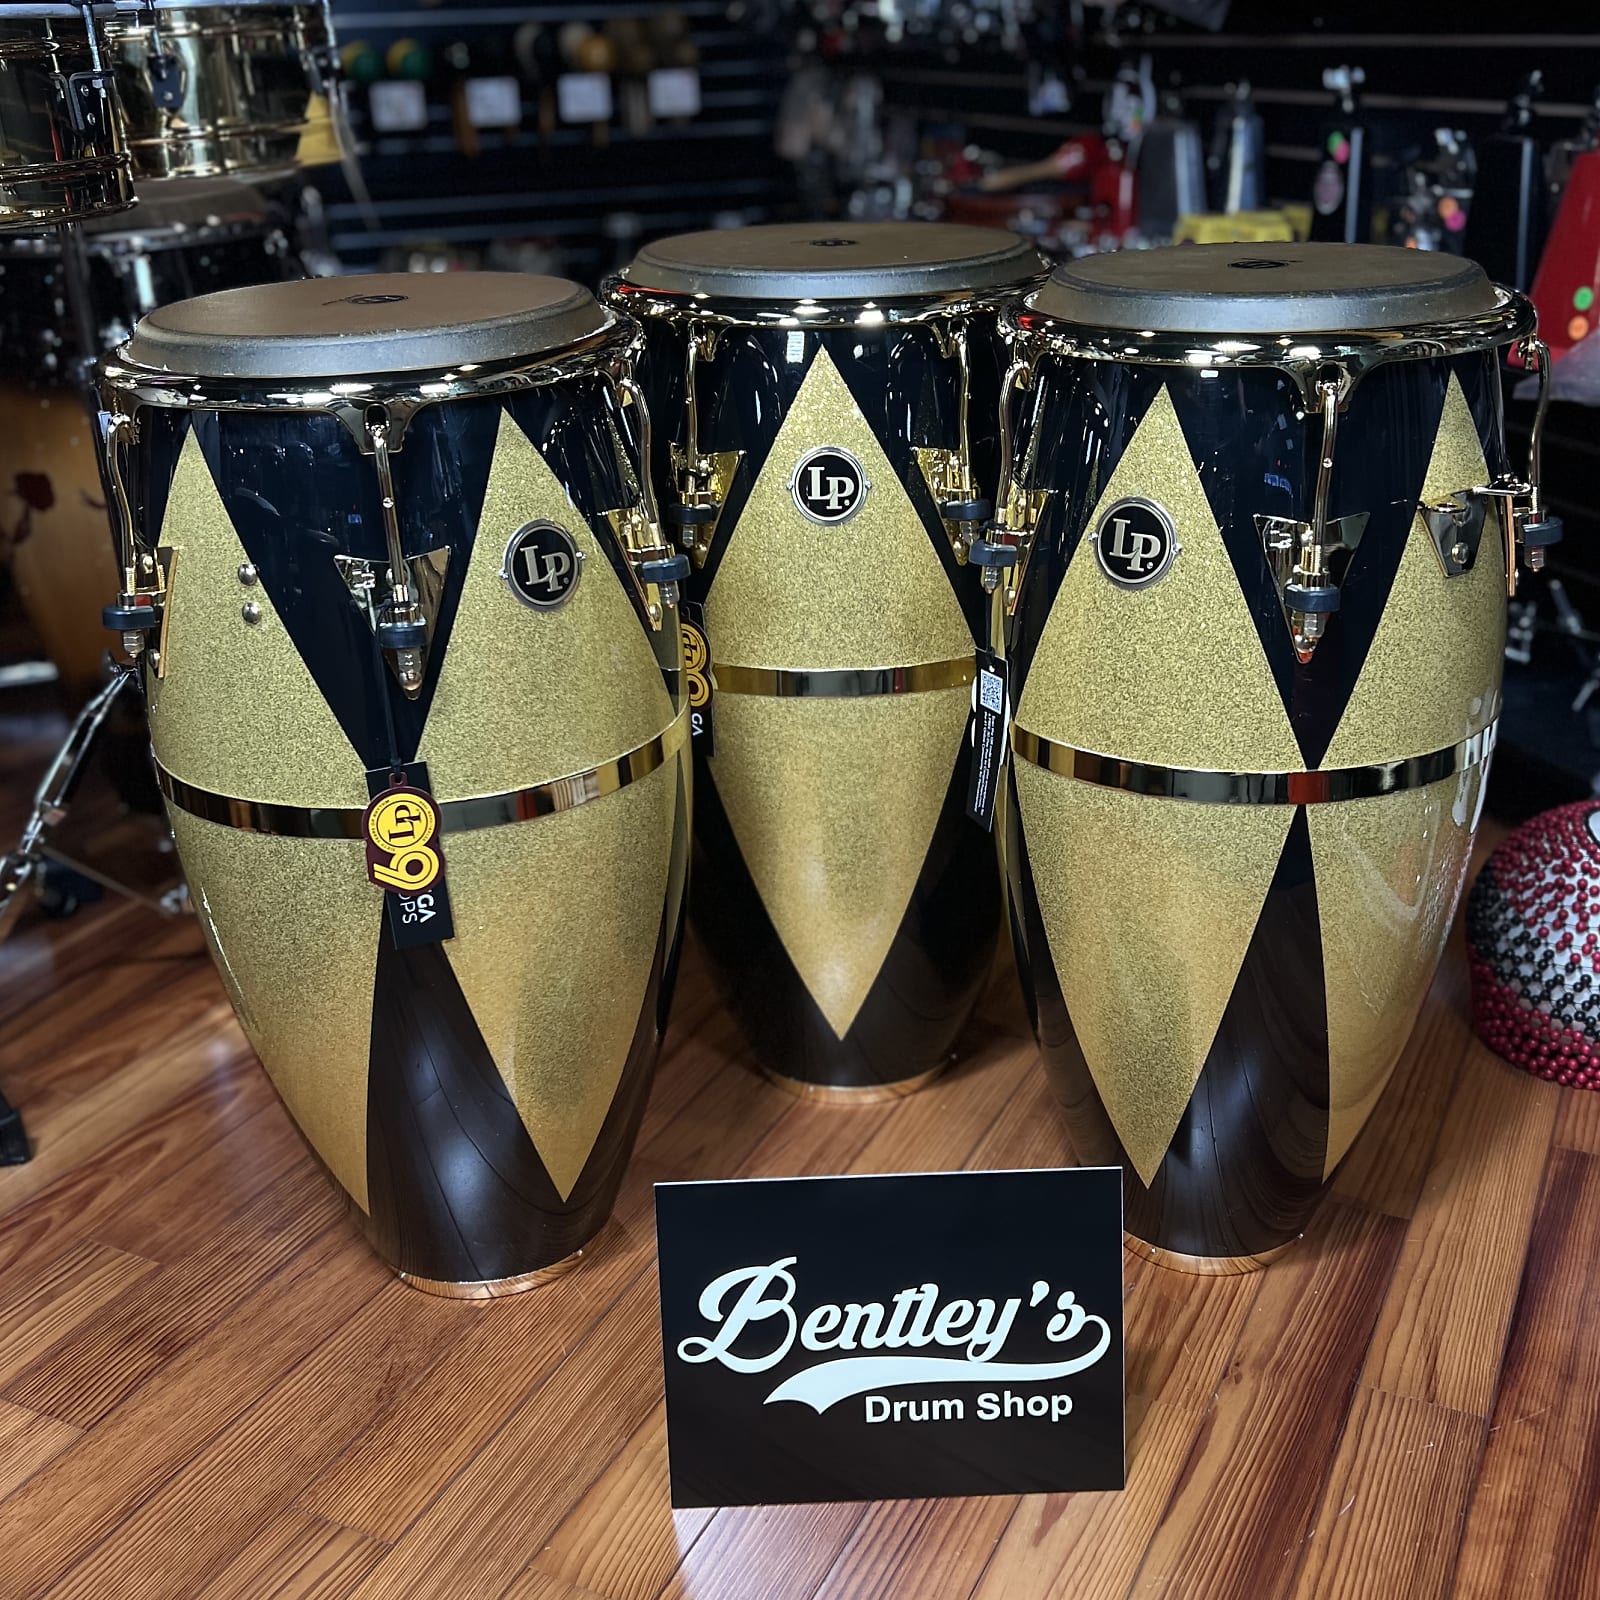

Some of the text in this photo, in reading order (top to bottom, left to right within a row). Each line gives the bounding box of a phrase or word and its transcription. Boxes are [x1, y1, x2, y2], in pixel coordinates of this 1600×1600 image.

[388, 804, 422, 843] LP
[677, 1256, 1111, 1374] Bentley's
[865, 1391, 1074, 1424] Drum Shop
